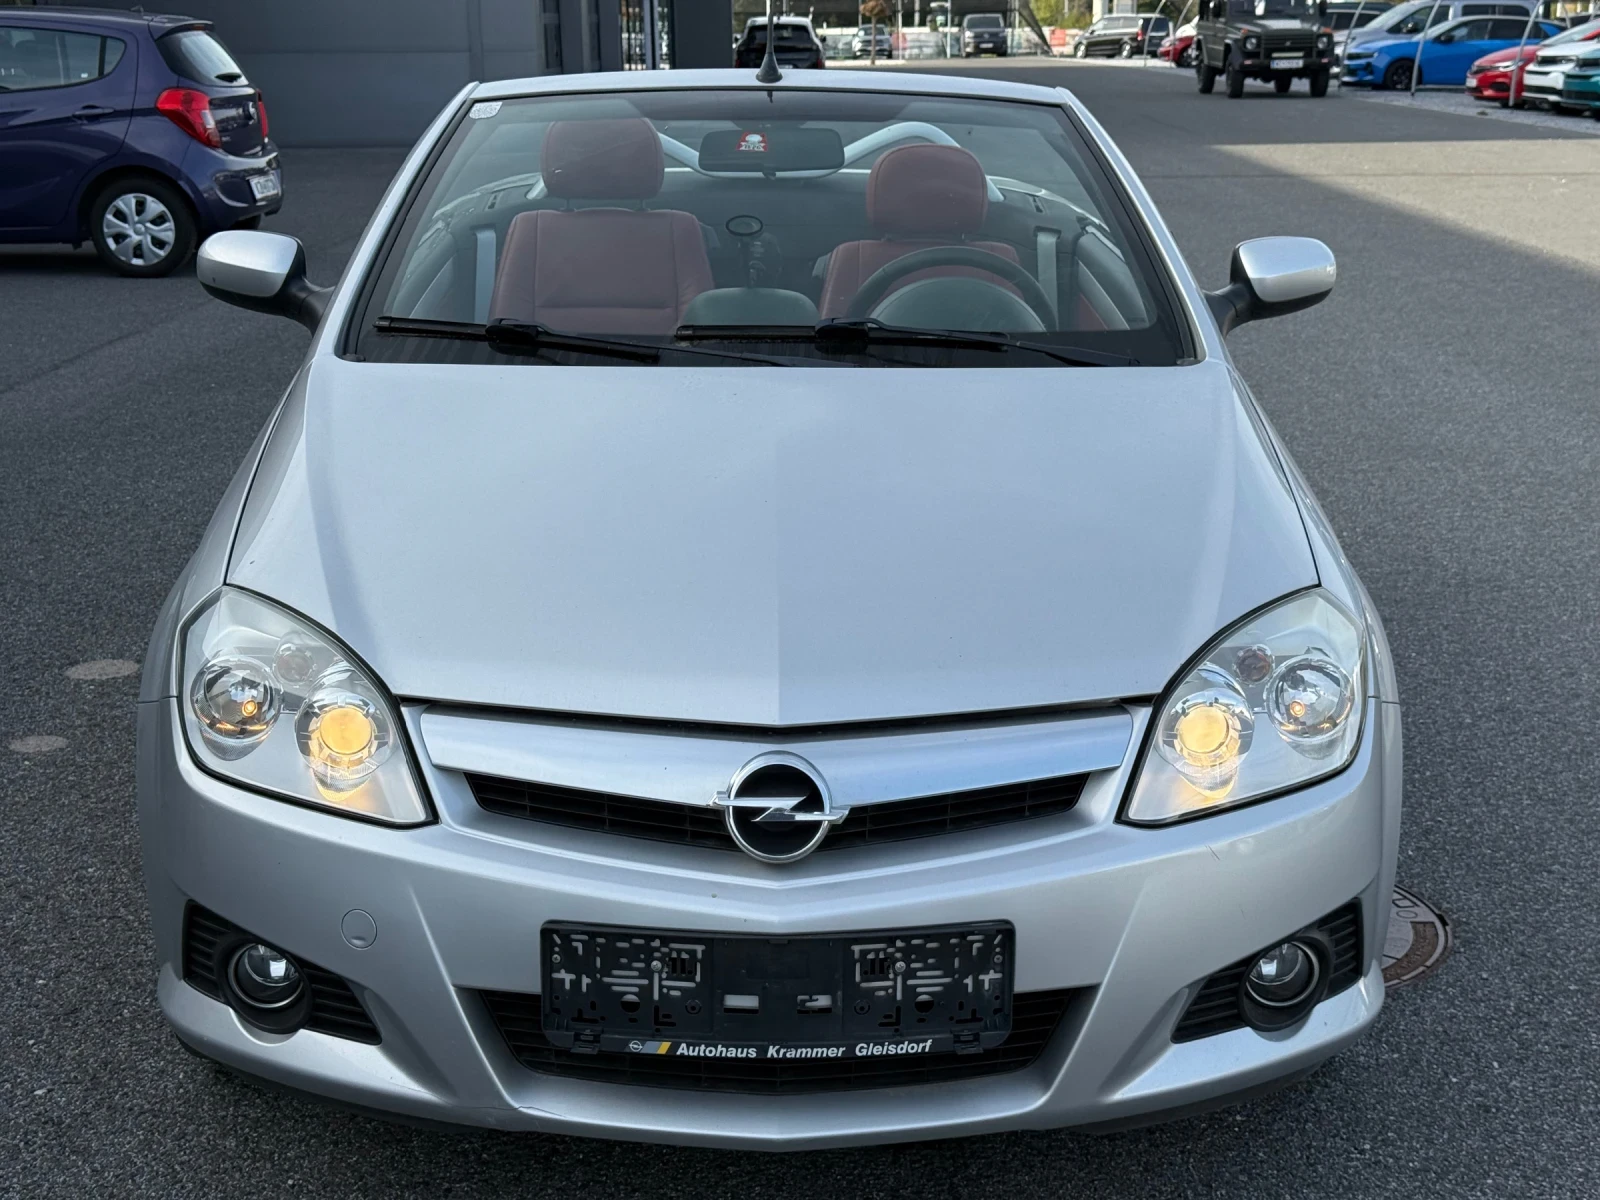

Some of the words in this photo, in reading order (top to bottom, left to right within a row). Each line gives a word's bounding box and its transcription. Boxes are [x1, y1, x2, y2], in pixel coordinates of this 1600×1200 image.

[676, 1042, 757, 1058] Autohaus
[767, 1045, 845, 1058] Krammer
[855, 1039, 932, 1056] Gleisdorf
